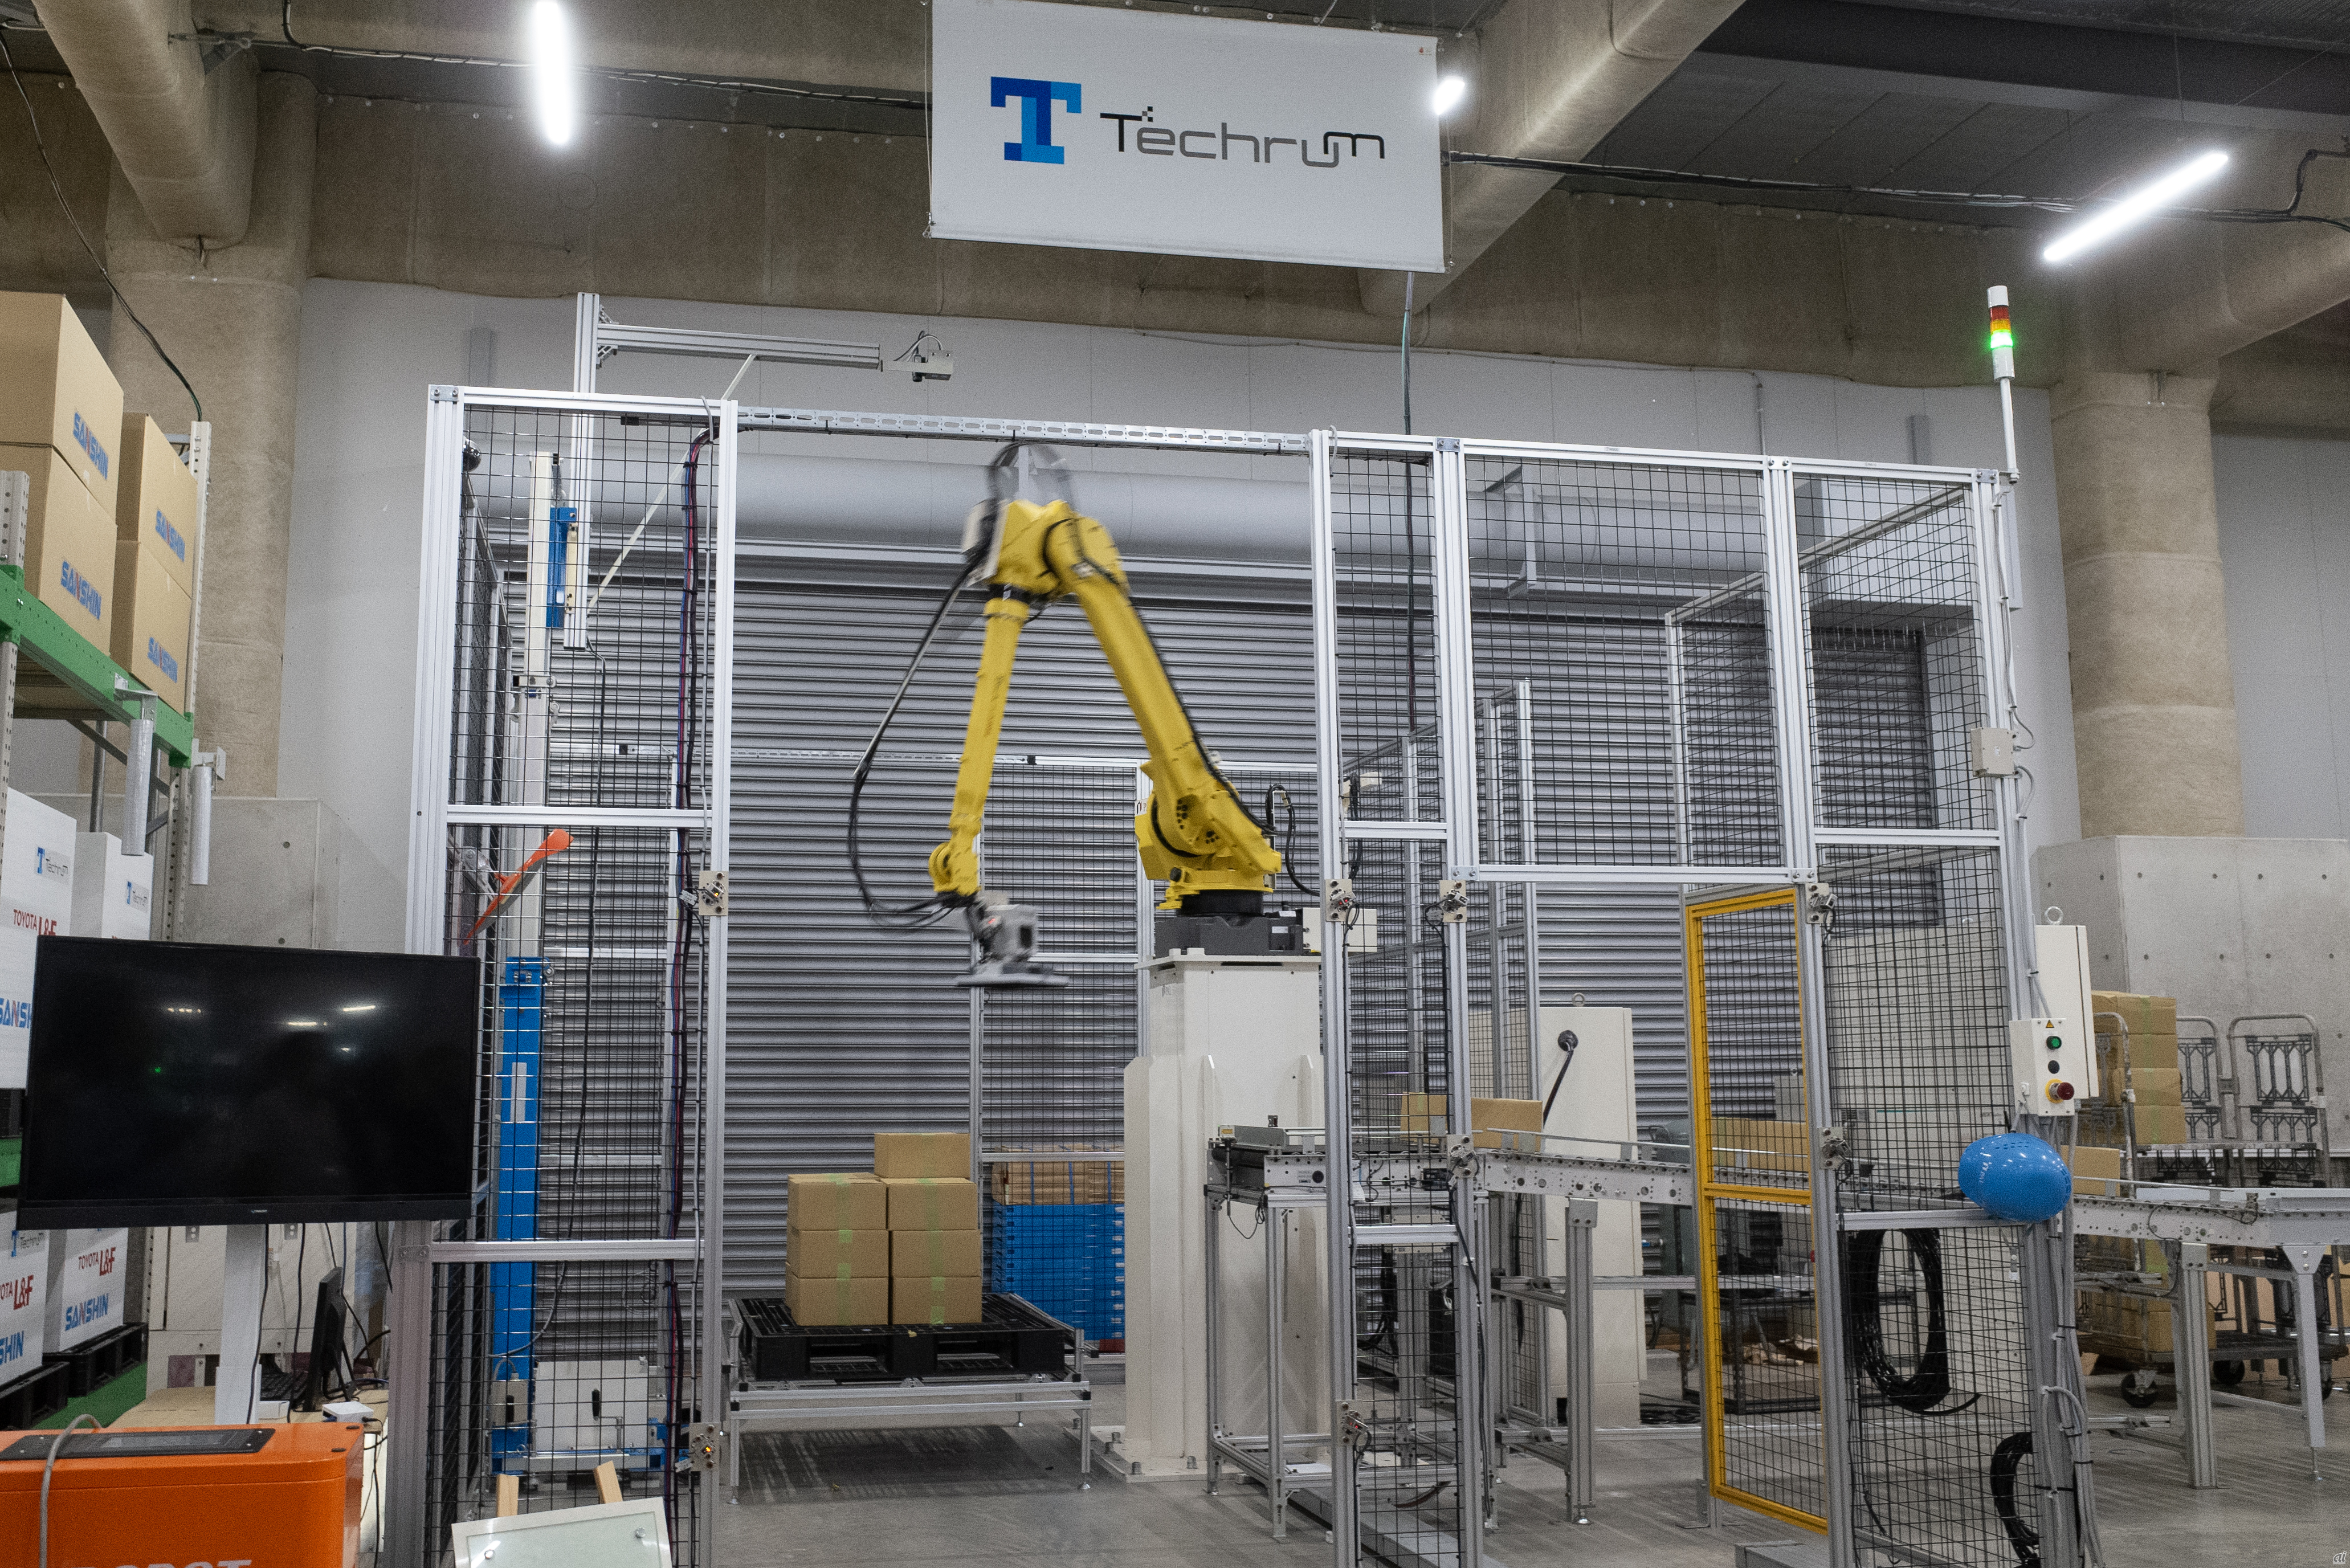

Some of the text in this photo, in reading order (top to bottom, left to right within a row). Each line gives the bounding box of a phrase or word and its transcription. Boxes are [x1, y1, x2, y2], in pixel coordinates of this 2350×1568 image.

[1100, 106, 1385, 168] Techrum
[72, 411, 108, 480] SANSHIN
[156, 509, 185, 563] SANSHIN
[60, 560, 101, 620] SANSHIN
[147, 636, 178, 683] SANSHIN
[13, 908, 38, 931] TOYOTA
[78, 1246, 116, 1276] TOYOTA L&F
[0, 1275, 34, 1310] OTA L&F
[65, 1293, 109, 1331] SANSHIN
